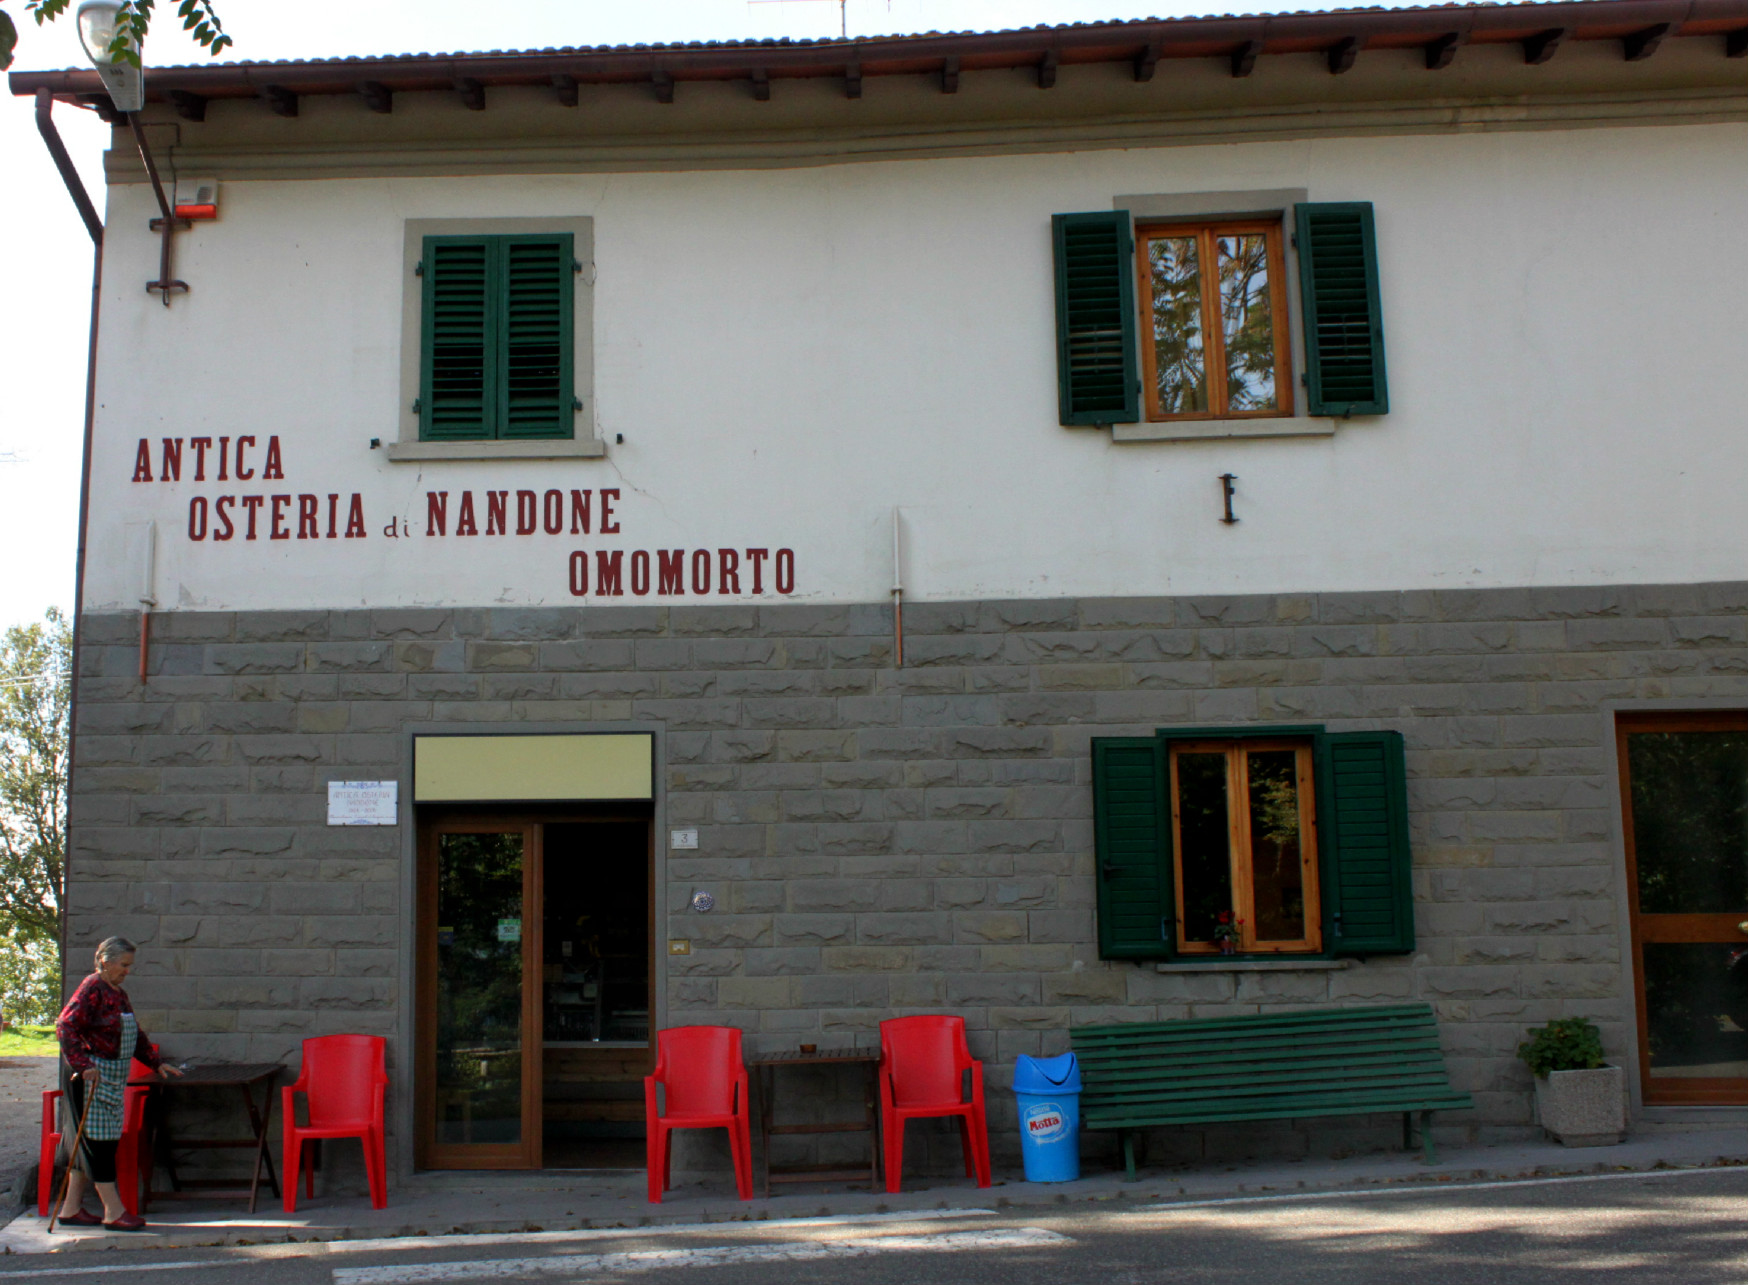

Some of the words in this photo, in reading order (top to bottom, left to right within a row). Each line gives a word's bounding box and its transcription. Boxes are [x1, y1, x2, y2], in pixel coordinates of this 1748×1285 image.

[131, 435, 285, 483] ANTICA
[188, 493, 367, 541] OSTERIA
[384, 516, 410, 539] di
[426, 488, 621, 536] NANDONE
[569, 548, 795, 597] OMOMORTO
[681, 833, 688, 844] 3
[1029, 1116, 1060, 1131] Motta
